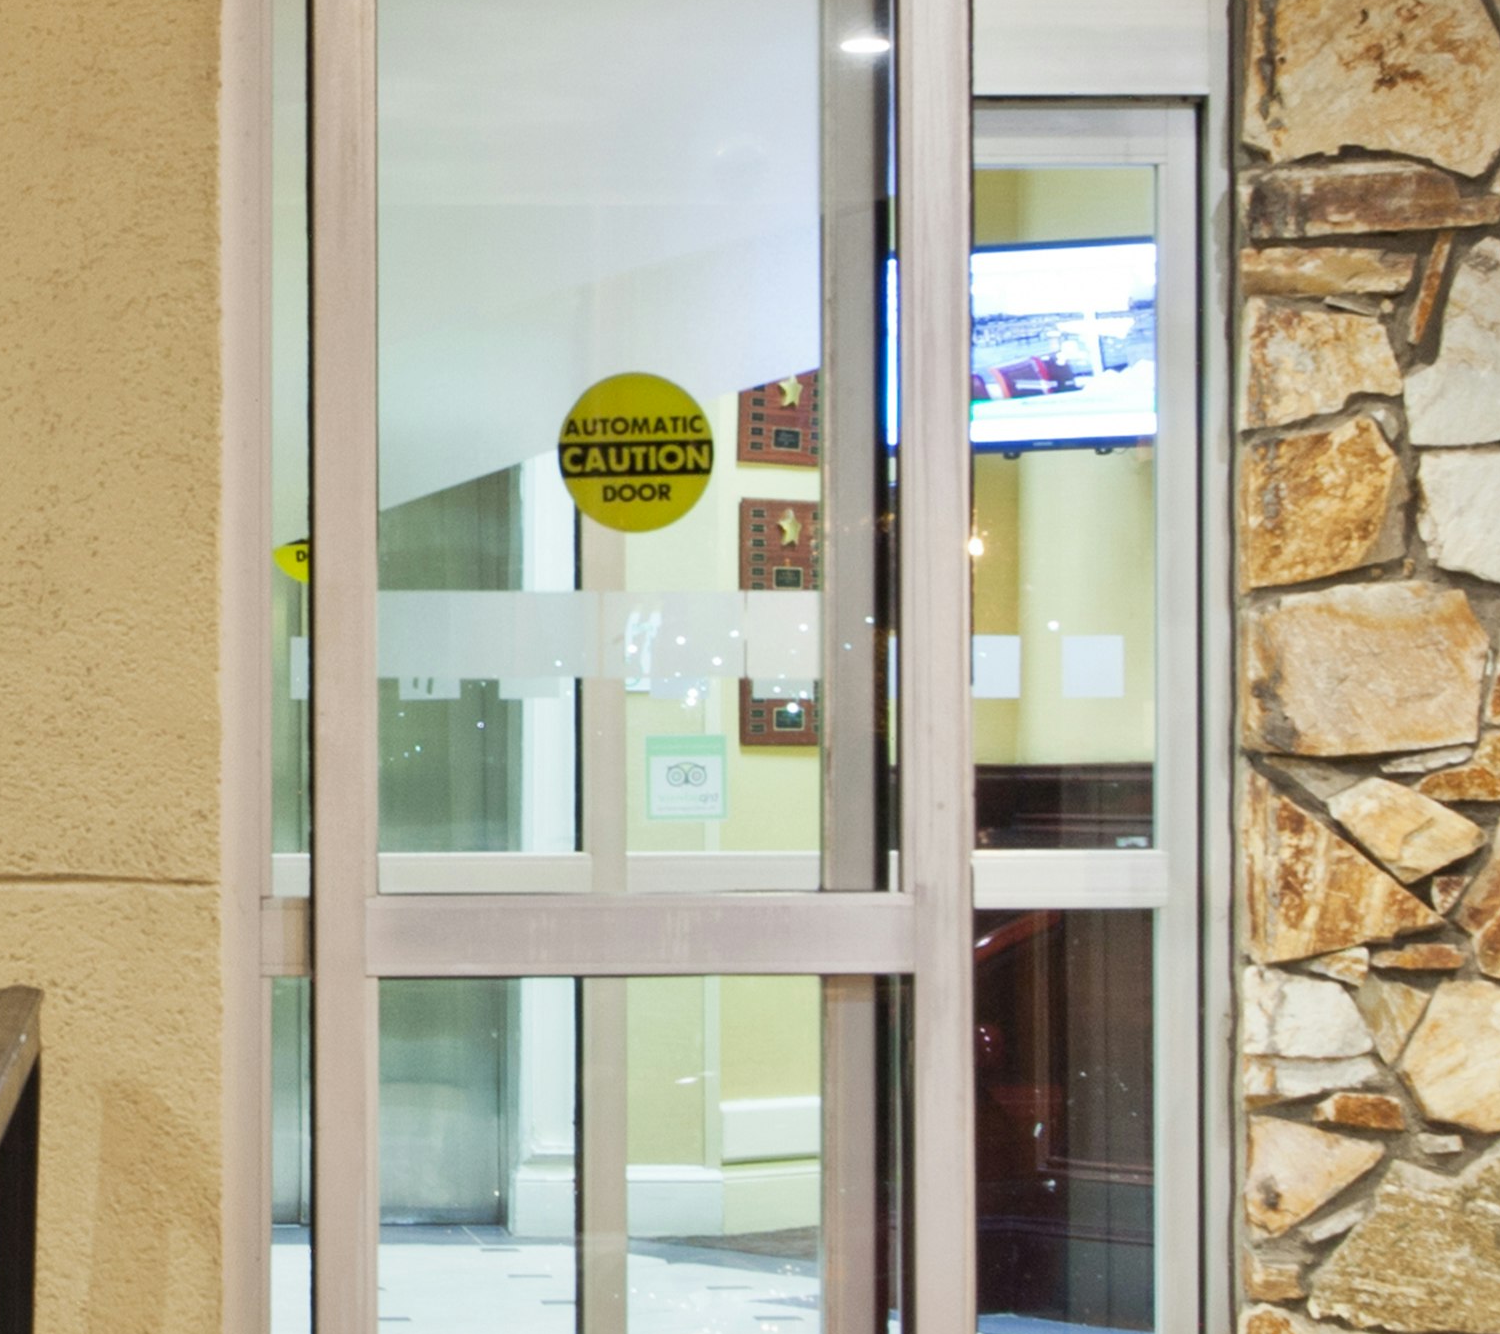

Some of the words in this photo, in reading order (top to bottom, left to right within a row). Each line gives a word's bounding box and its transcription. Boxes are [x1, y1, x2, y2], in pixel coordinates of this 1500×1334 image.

[564, 414, 704, 437] AUTOMATIC
[562, 443, 710, 474] CAUTION
[602, 483, 672, 503] DOOR
